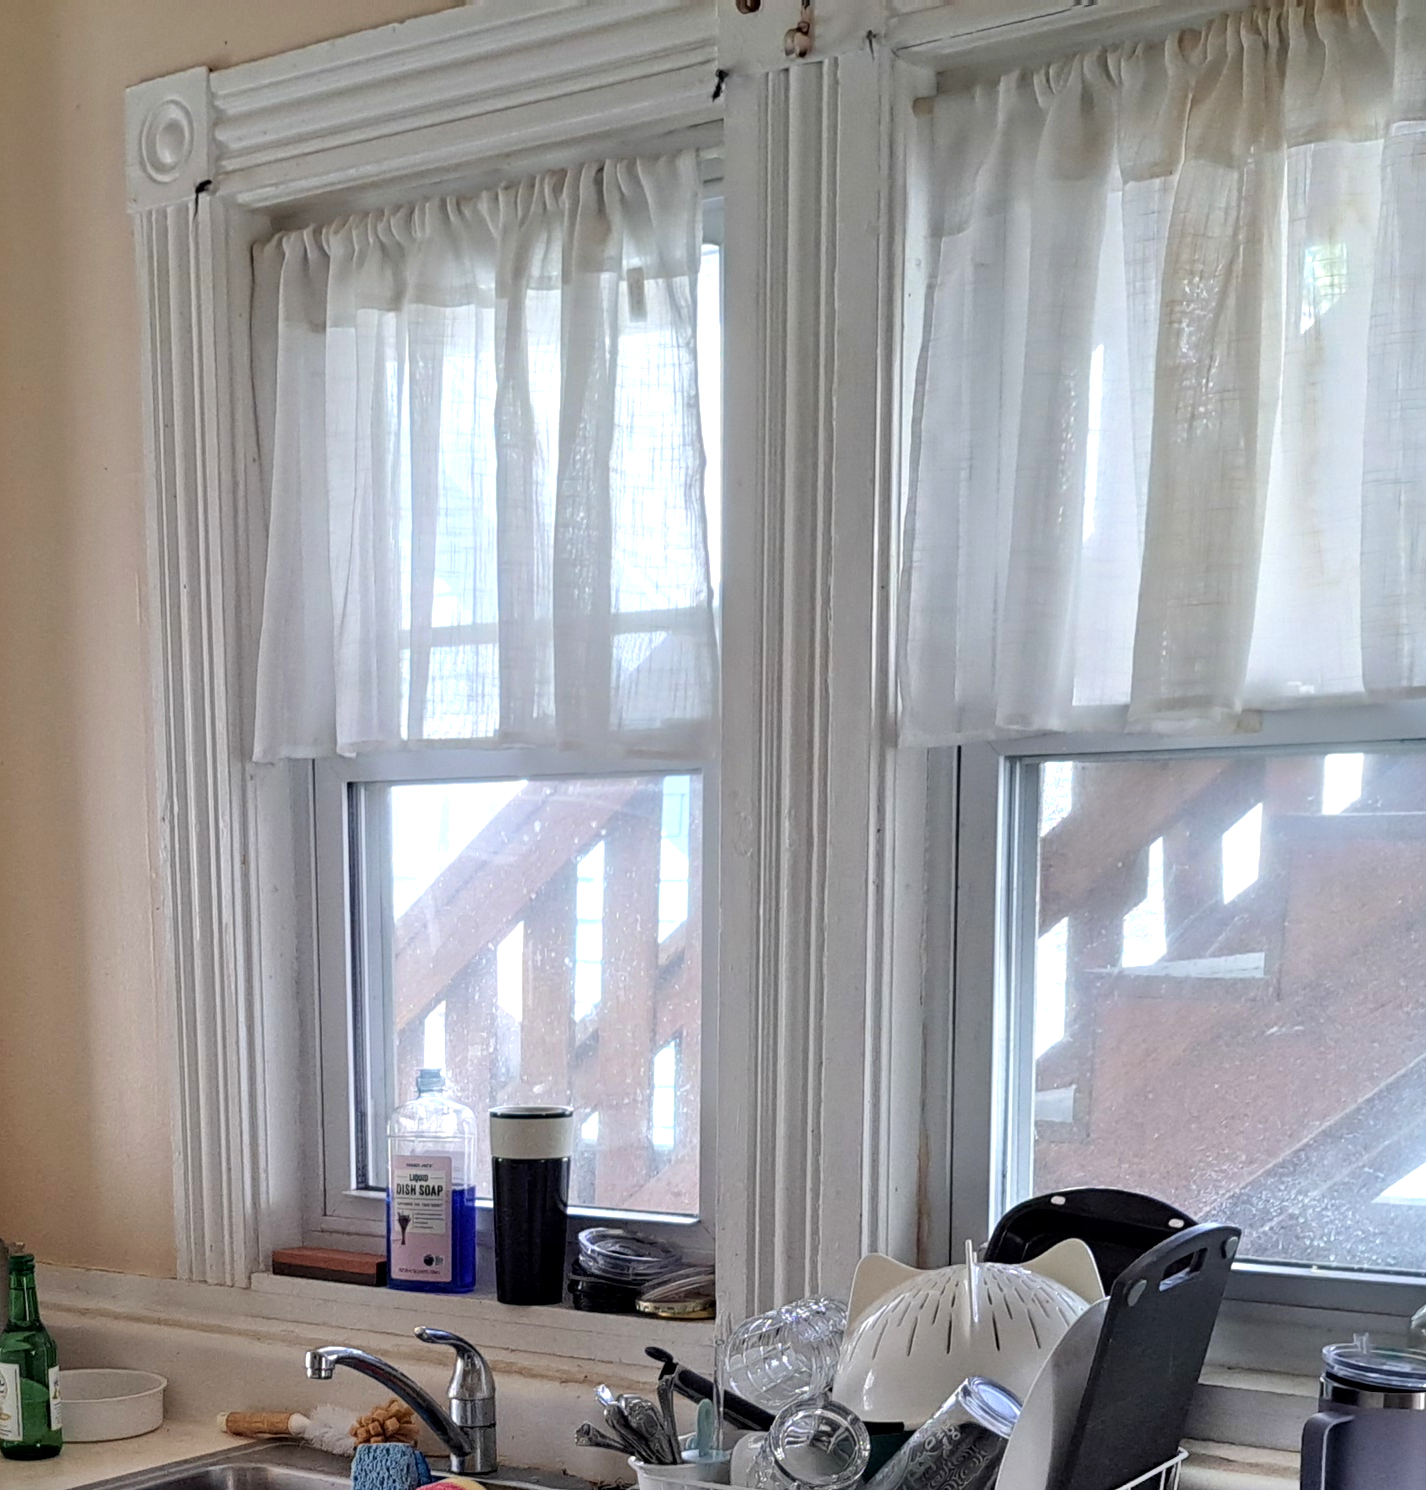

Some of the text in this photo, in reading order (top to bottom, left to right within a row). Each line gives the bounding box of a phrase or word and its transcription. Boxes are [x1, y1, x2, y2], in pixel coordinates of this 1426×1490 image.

[409, 1174, 429, 1183] LIQUID
[396, 1183, 444, 1197] DISH SOAP
